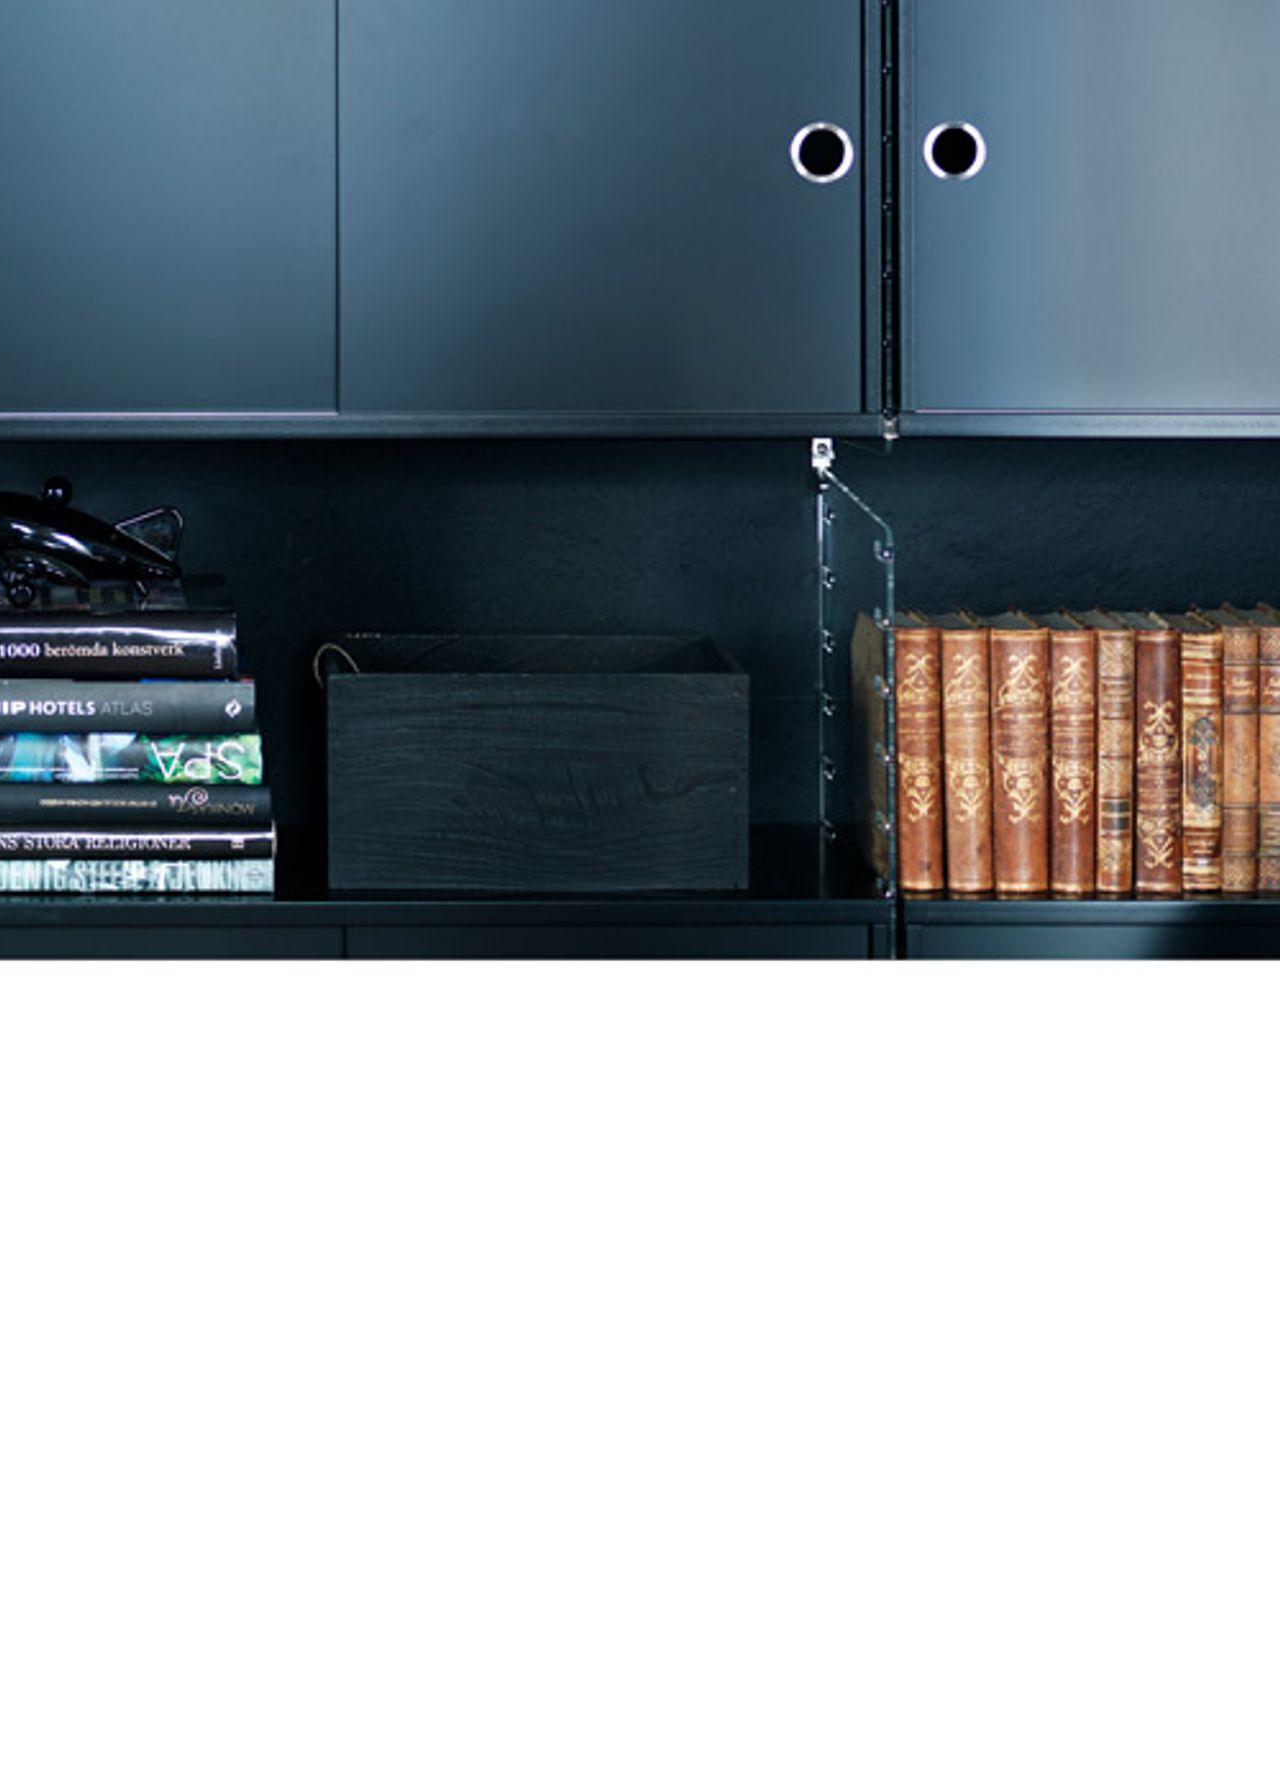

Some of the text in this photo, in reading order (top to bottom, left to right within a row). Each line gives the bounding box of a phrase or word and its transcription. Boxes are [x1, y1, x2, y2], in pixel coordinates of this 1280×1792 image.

[43, 642, 108, 657] berömda
[111, 641, 185, 657] konstverk
[29, 700, 96, 716] HOTELS
[100, 701, 153, 716] ATLAS
[151, 740, 245, 780] SPA
[23, 835, 80, 851] STORA
[86, 835, 192, 851] RELIGIONER
